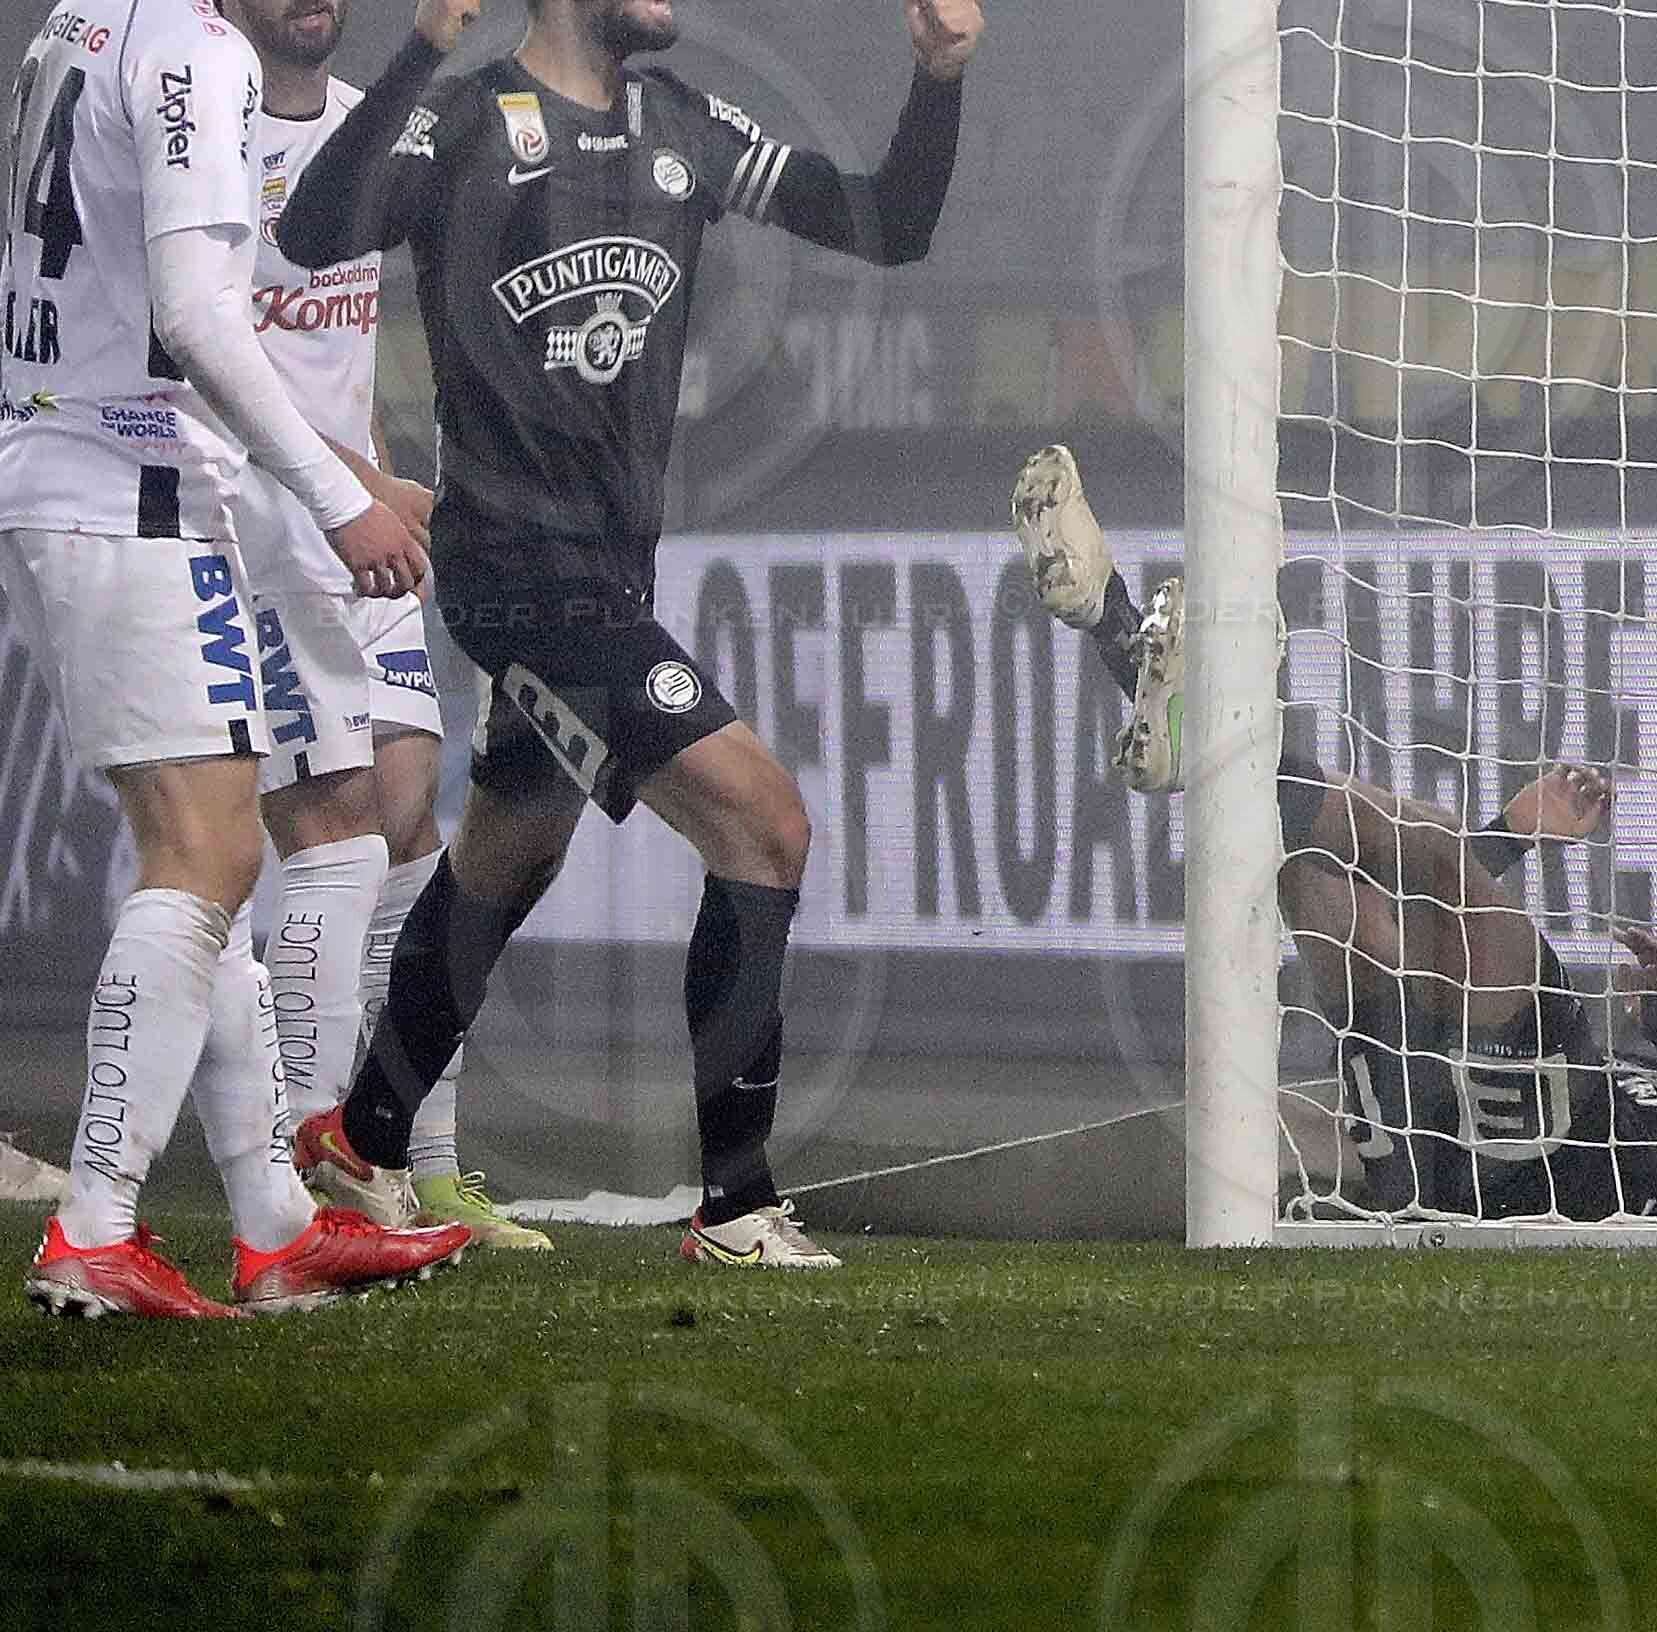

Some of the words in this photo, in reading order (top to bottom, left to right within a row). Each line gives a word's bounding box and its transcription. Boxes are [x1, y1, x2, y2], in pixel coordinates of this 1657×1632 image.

[155, 64, 197, 171] Zipfer
[509, 245, 671, 310] PUNTIGAMER
[189, 554, 257, 711] BWT
[256, 608, 319, 744] BWT
[271, 912, 325, 982] LUCE
[92, 973, 137, 1052] LUCE
[273, 990, 319, 1090] MOLTO
[83, 1061, 127, 1182] MOLTO
